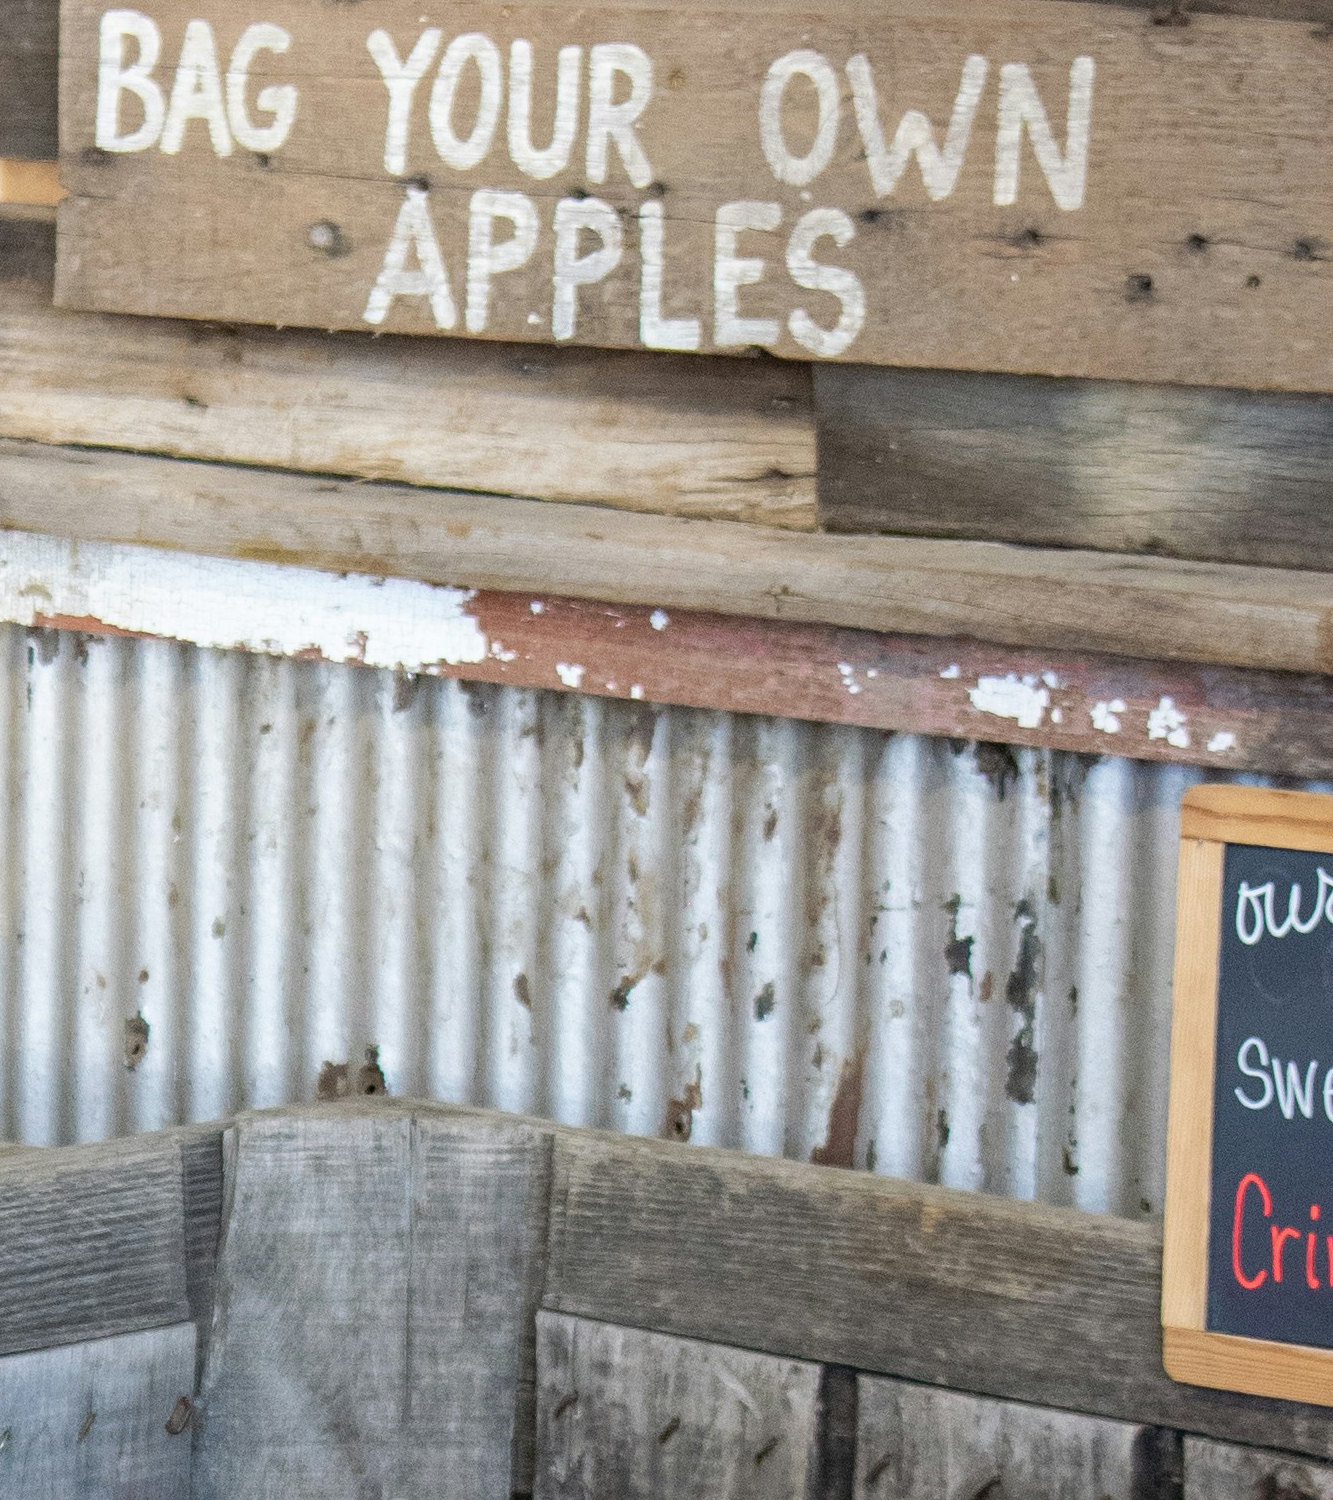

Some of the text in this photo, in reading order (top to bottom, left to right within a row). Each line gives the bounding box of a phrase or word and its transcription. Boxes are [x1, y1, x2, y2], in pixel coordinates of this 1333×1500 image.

[95, 9, 1096, 211] BAG YOUR OWN
[363, 188, 866, 357] APPLES
[1232, 1171, 1333, 1290] Cri
